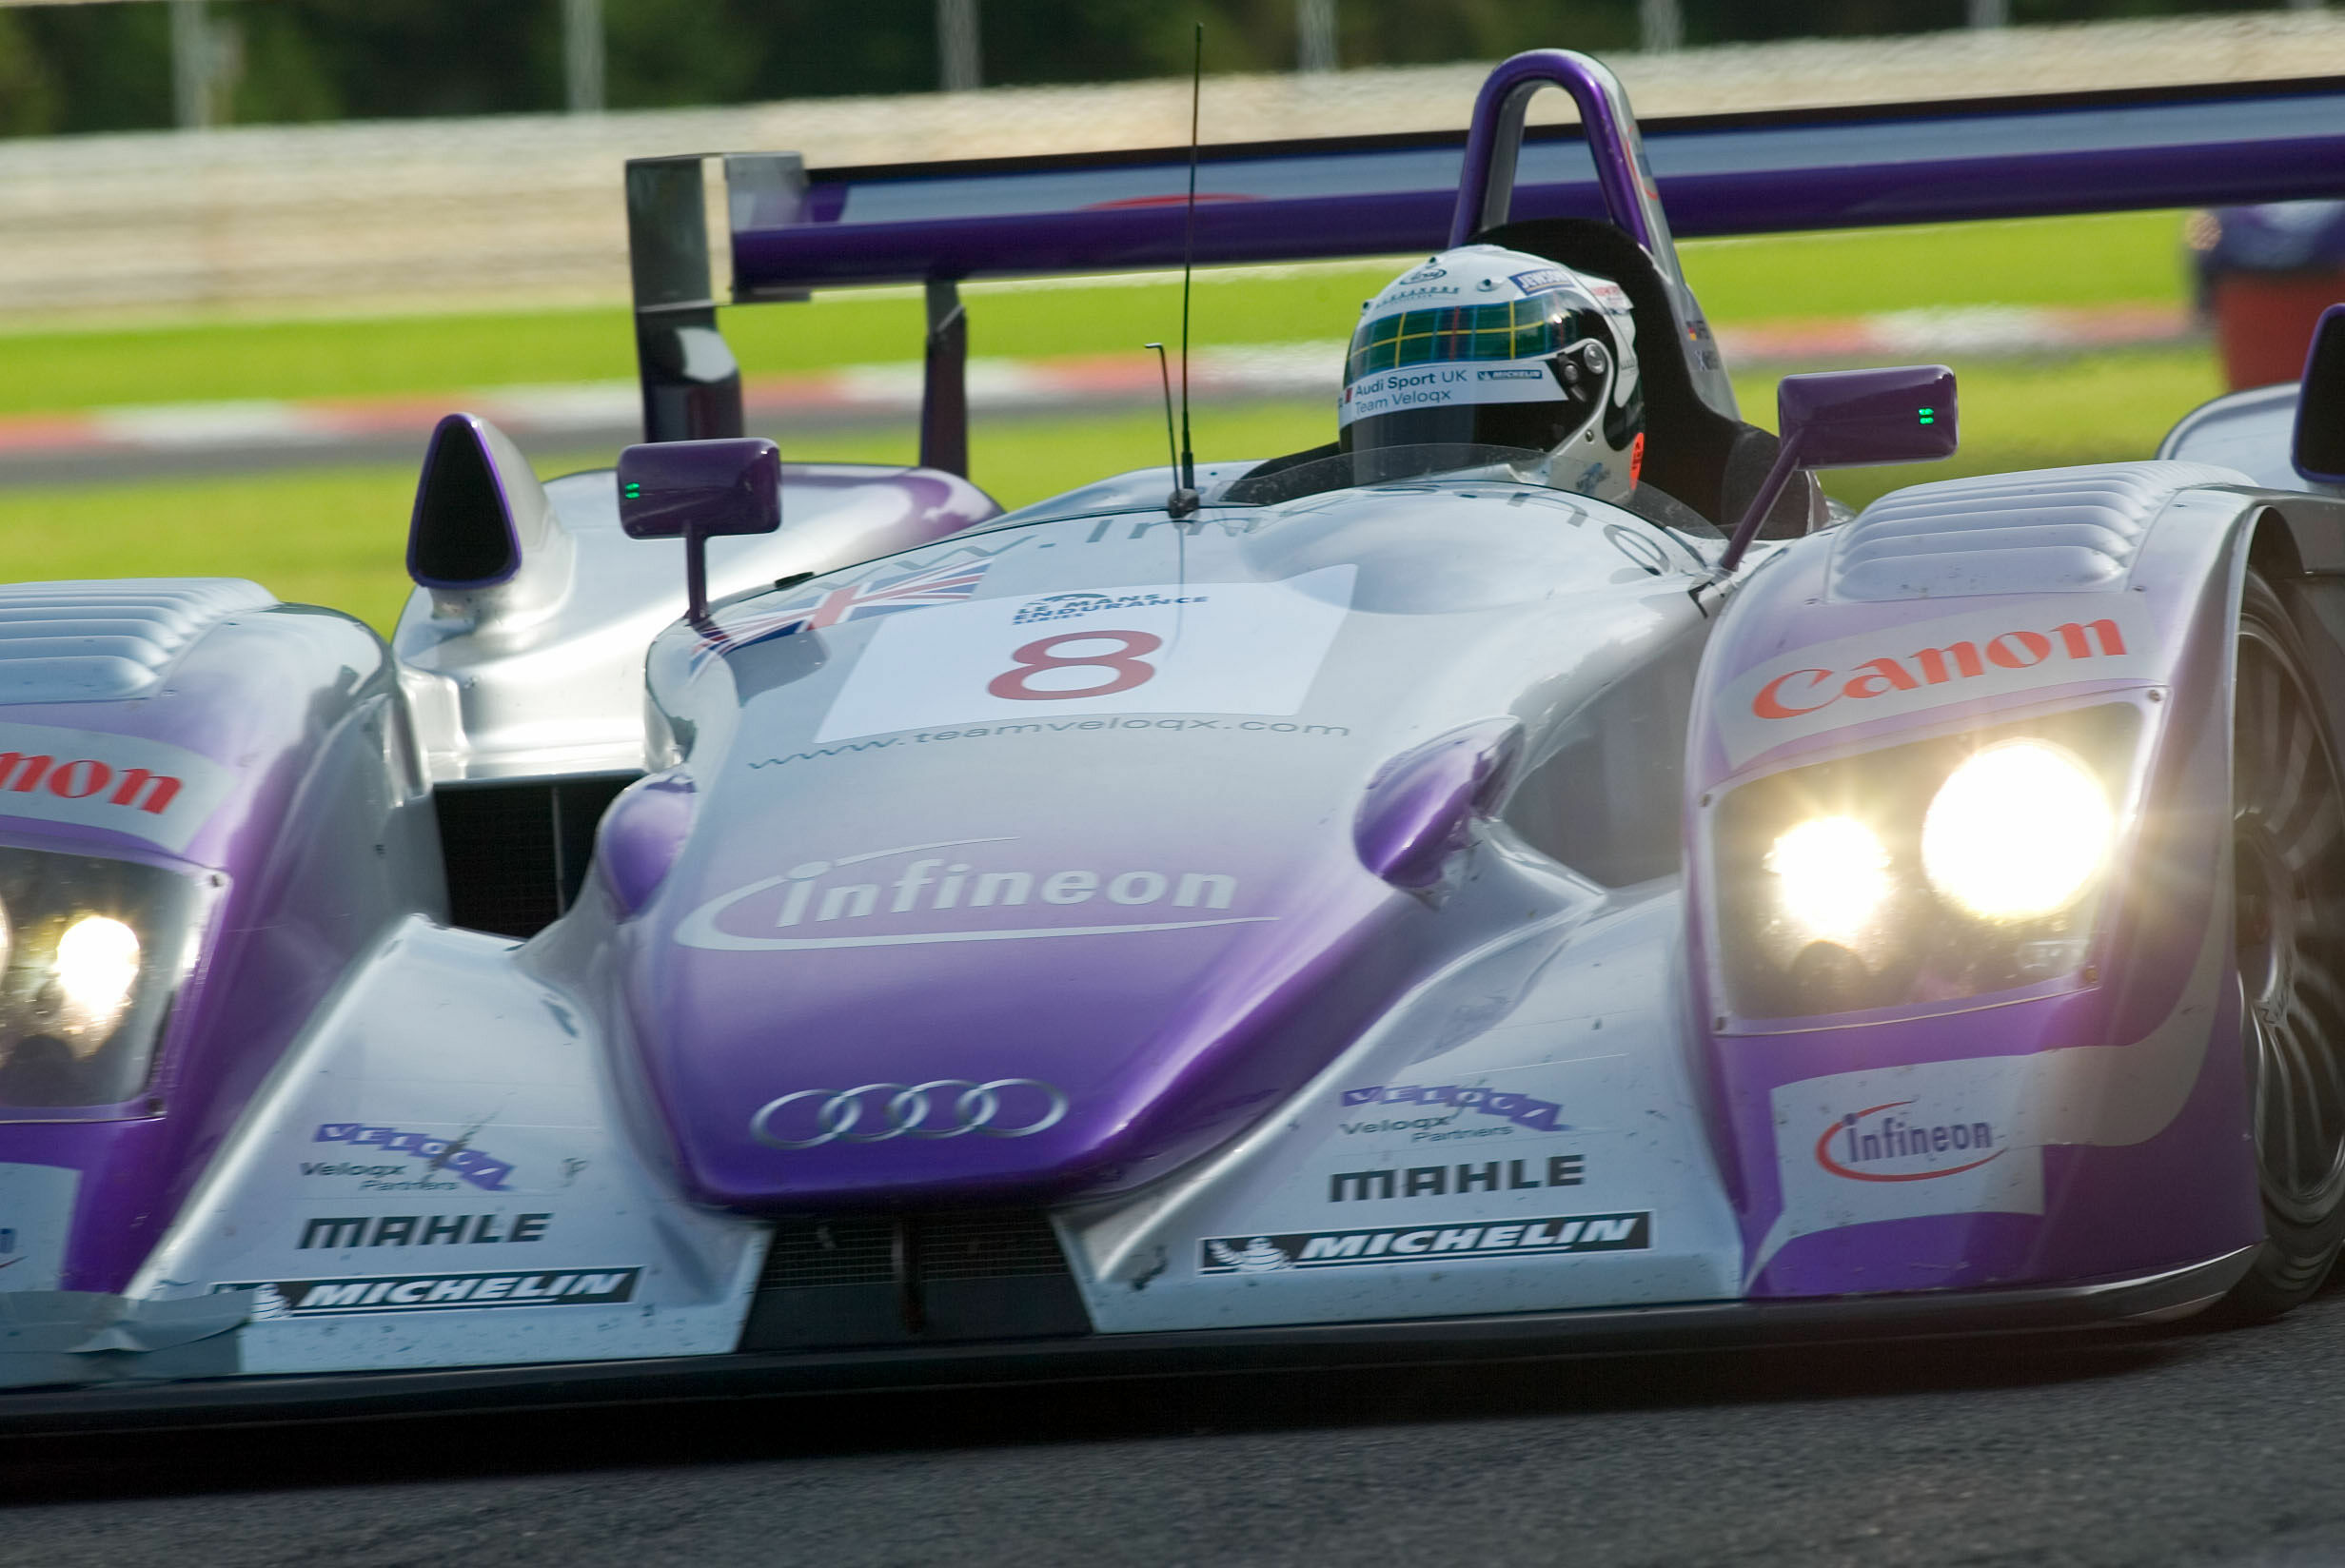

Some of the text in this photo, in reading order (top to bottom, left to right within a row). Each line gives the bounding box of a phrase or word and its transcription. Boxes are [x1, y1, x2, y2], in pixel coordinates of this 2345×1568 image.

[1355, 369, 1468, 398] Audi Sport UK
[1355, 399, 1389, 415] Team
[1391, 389, 1451, 405] Veloqx
[1012, 596, 1211, 620] ENDURANCE
[1017, 593, 1161, 615] LE MANS
[987, 629, 1163, 701] 8
[1752, 618, 2127, 719] Canon
[748, 715, 1350, 770] www.teamveloqx.com
[775, 858, 1238, 929] infineon
[1339, 1116, 1451, 1135] Veloqx
[1410, 1126, 1514, 1144] Partners
[299, 1162, 408, 1178] Veloqx
[358, 1180, 461, 1191] Partners
[1329, 1154, 1586, 1203] MAHLE
[296, 1212, 555, 1250] MAHLE
[1297, 1218, 1639, 1260] MICHELIN
[297, 1272, 626, 1308] MICHELIN
